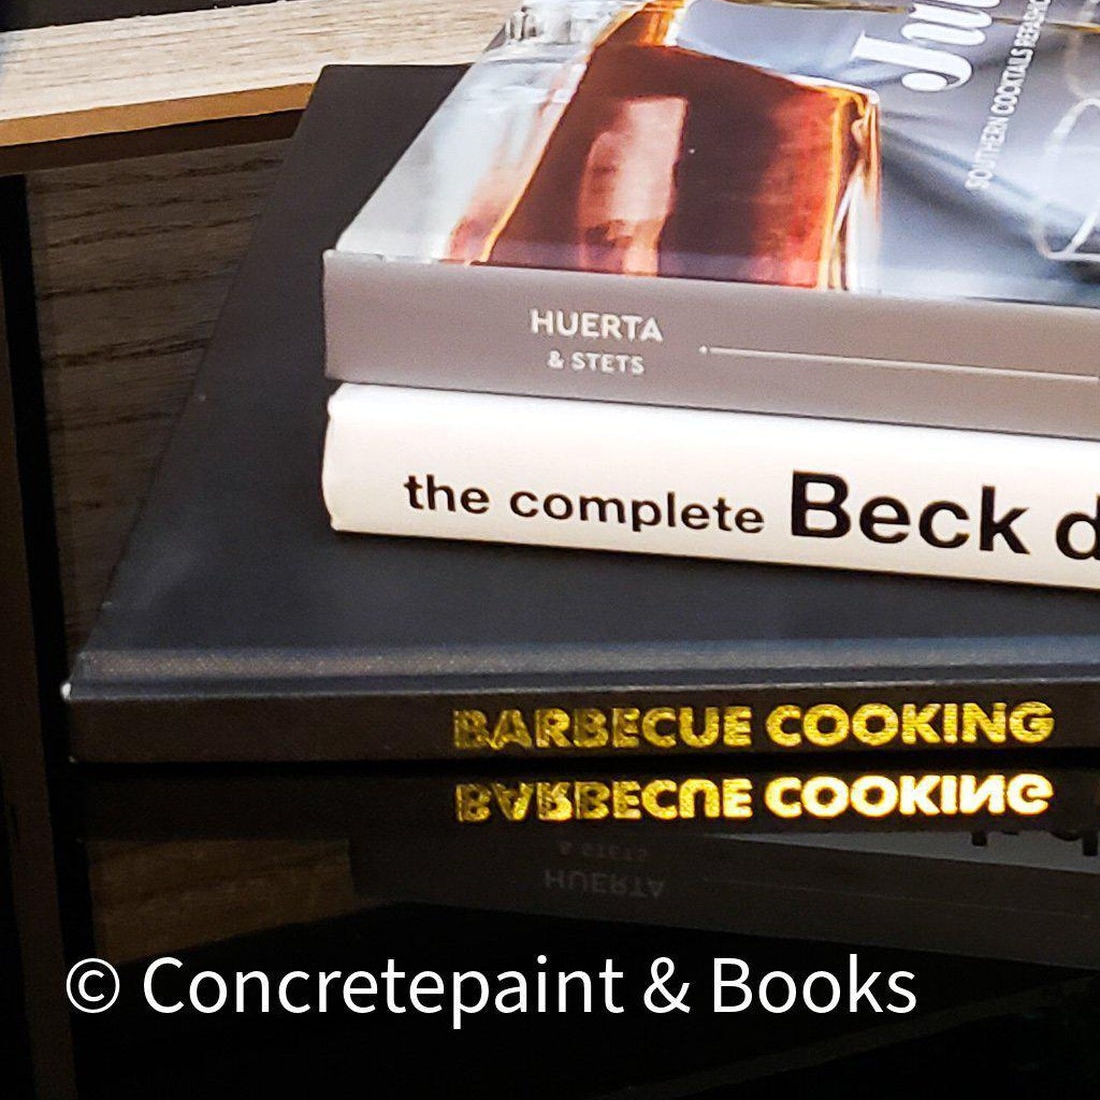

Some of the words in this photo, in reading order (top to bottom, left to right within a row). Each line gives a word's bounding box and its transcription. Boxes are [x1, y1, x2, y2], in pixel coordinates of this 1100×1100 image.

[964, 116, 1009, 190] SOUTHERN
[990, 48, 1034, 116] COCKTAILS
[530, 308, 664, 343] HUERTA
[547, 350, 565, 370] &
[571, 350, 646, 376] STETS
[403, 474, 490, 515] the
[508, 491, 766, 534] complete
[790, 470, 1031, 556] Beck
[452, 705, 753, 750] BARBECUE
[766, 701, 1056, 747] COOKING
